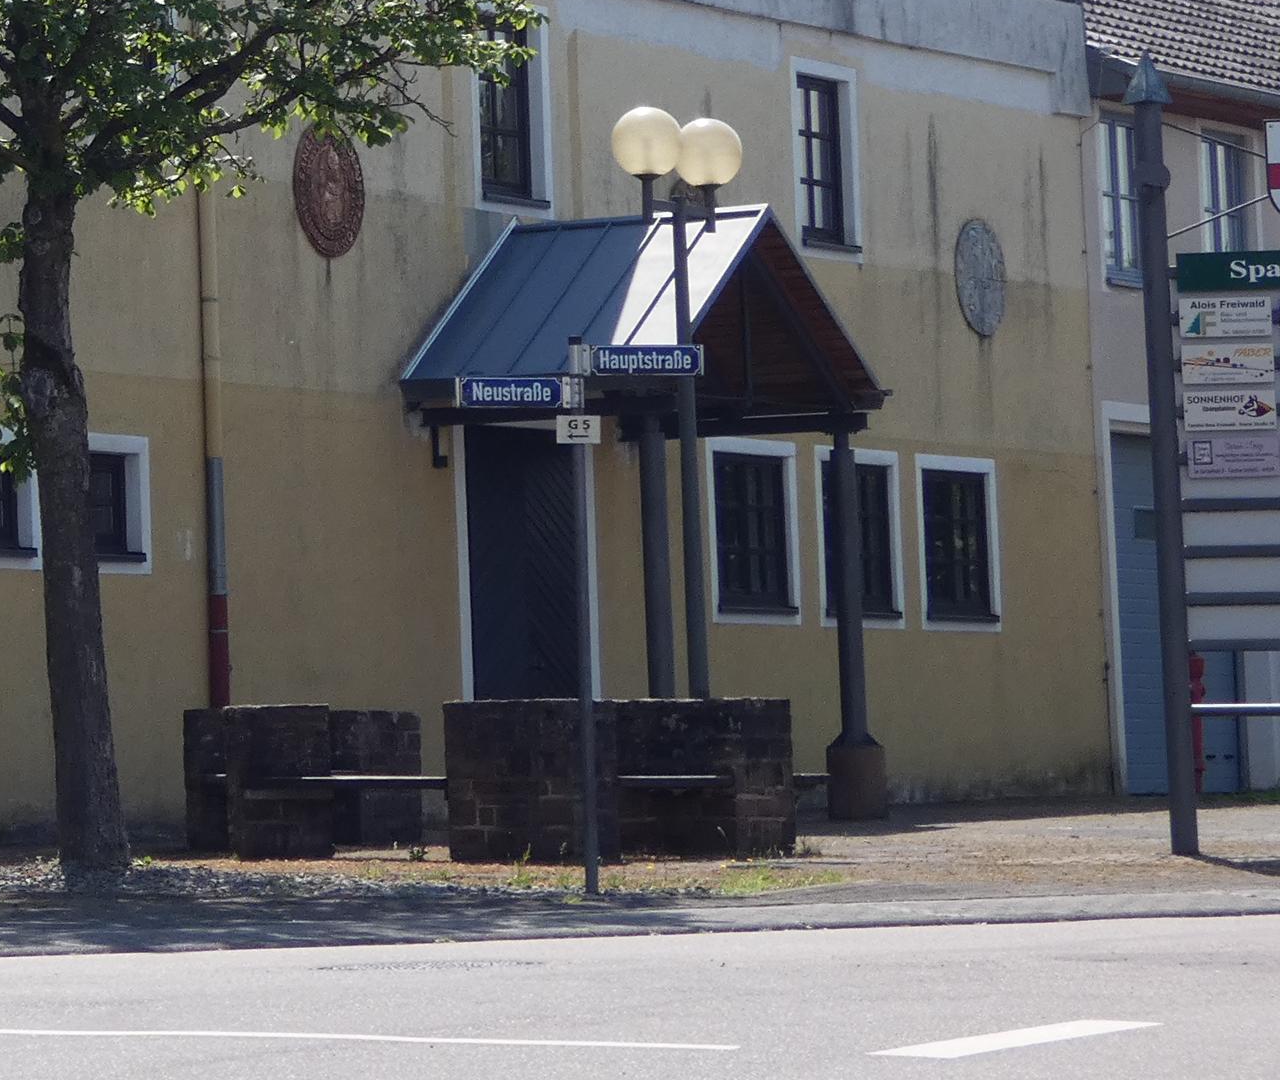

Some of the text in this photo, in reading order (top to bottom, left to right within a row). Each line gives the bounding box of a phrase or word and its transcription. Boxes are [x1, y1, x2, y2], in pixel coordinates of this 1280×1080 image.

[1229, 259, 1280, 283] Spa
[1190, 299, 1266, 309] Alois Freiwald
[599, 350, 691, 373] Hauptstraße
[472, 381, 551, 403] Neustraße
[1186, 394, 1245, 405] SONNENHOF
[568, 419, 591, 430] G 5
